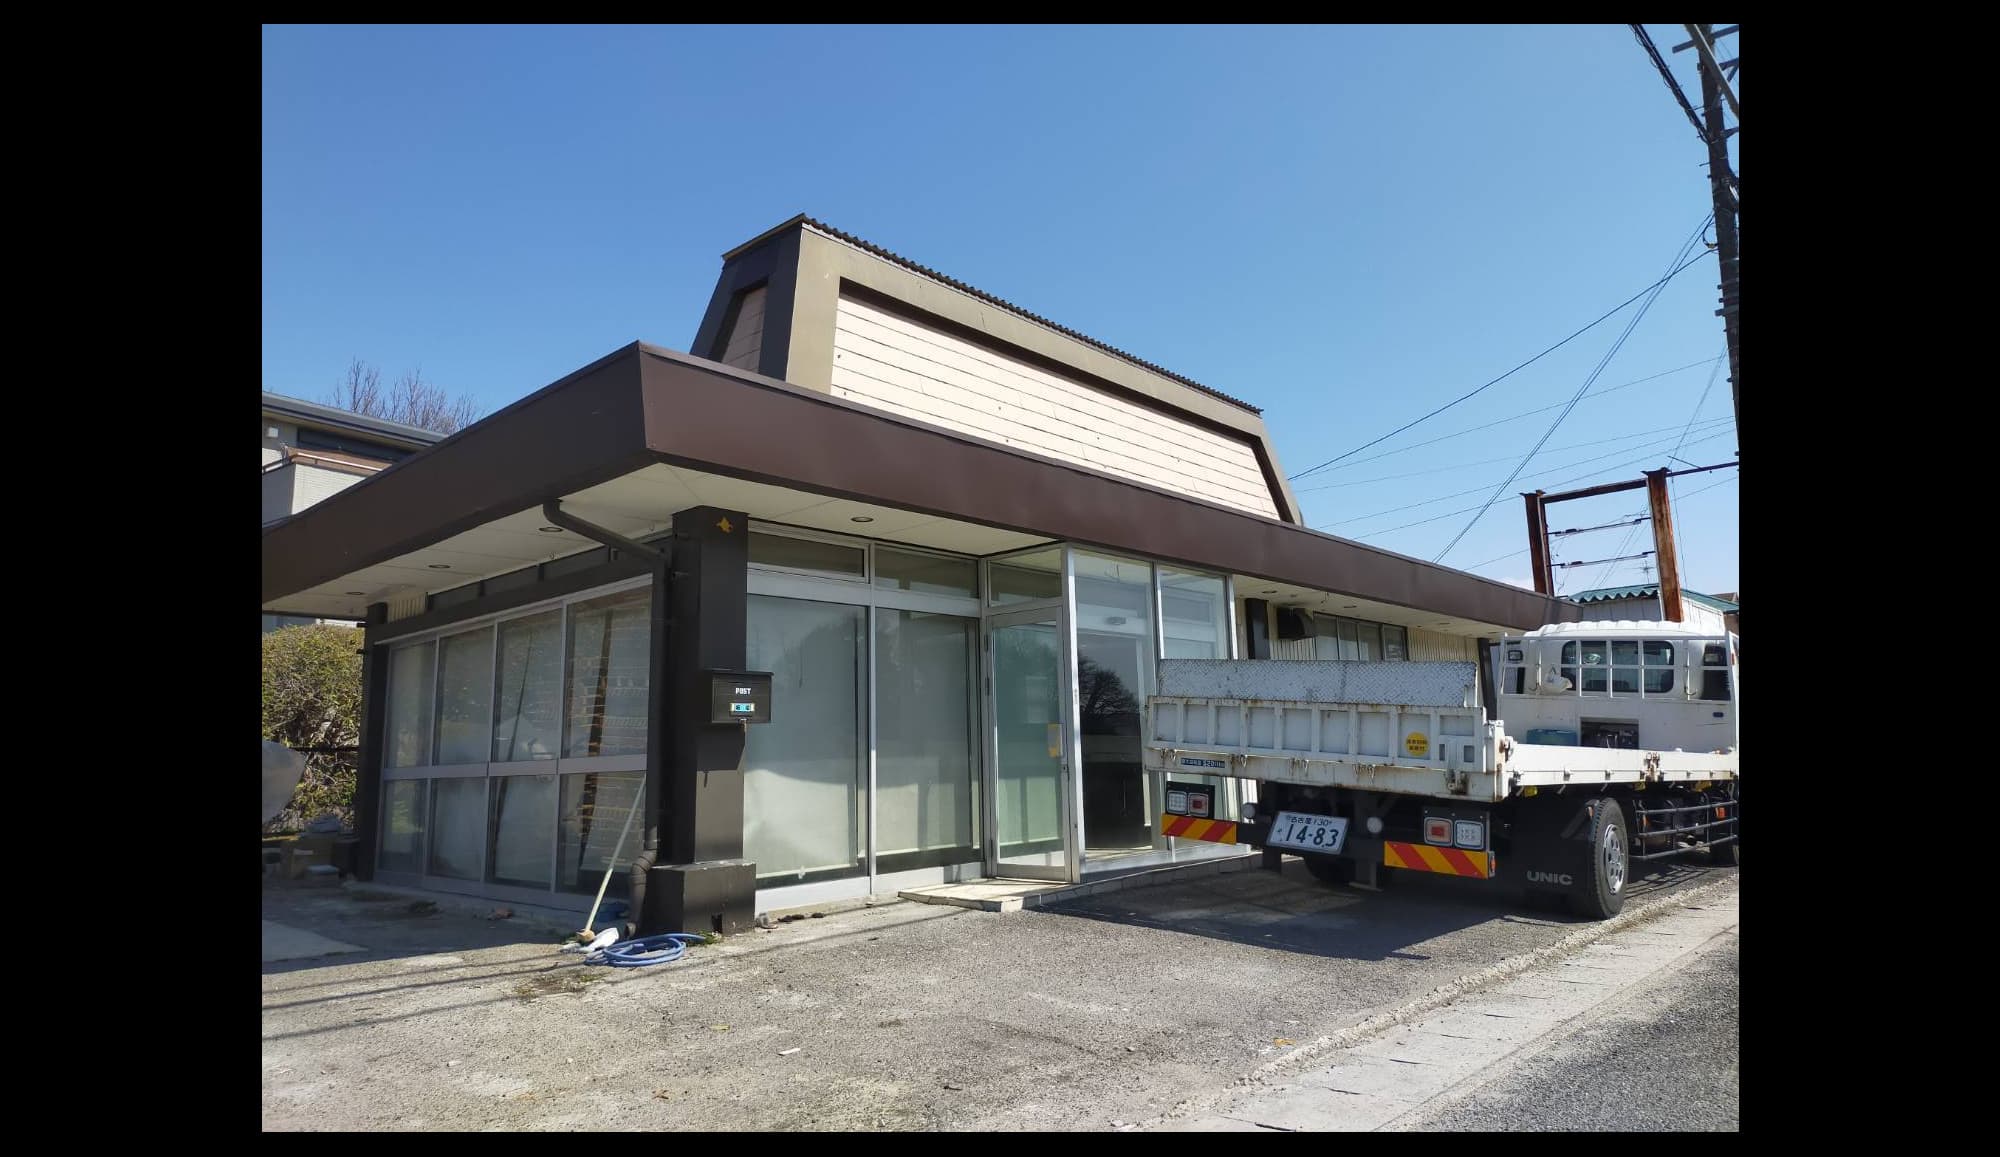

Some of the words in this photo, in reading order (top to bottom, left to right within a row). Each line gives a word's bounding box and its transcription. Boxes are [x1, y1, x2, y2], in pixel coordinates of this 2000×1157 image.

[735, 687, 751, 695] POST
[1286, 823, 1339, 847] 14-83
[1526, 870, 1573, 885] UNIC
